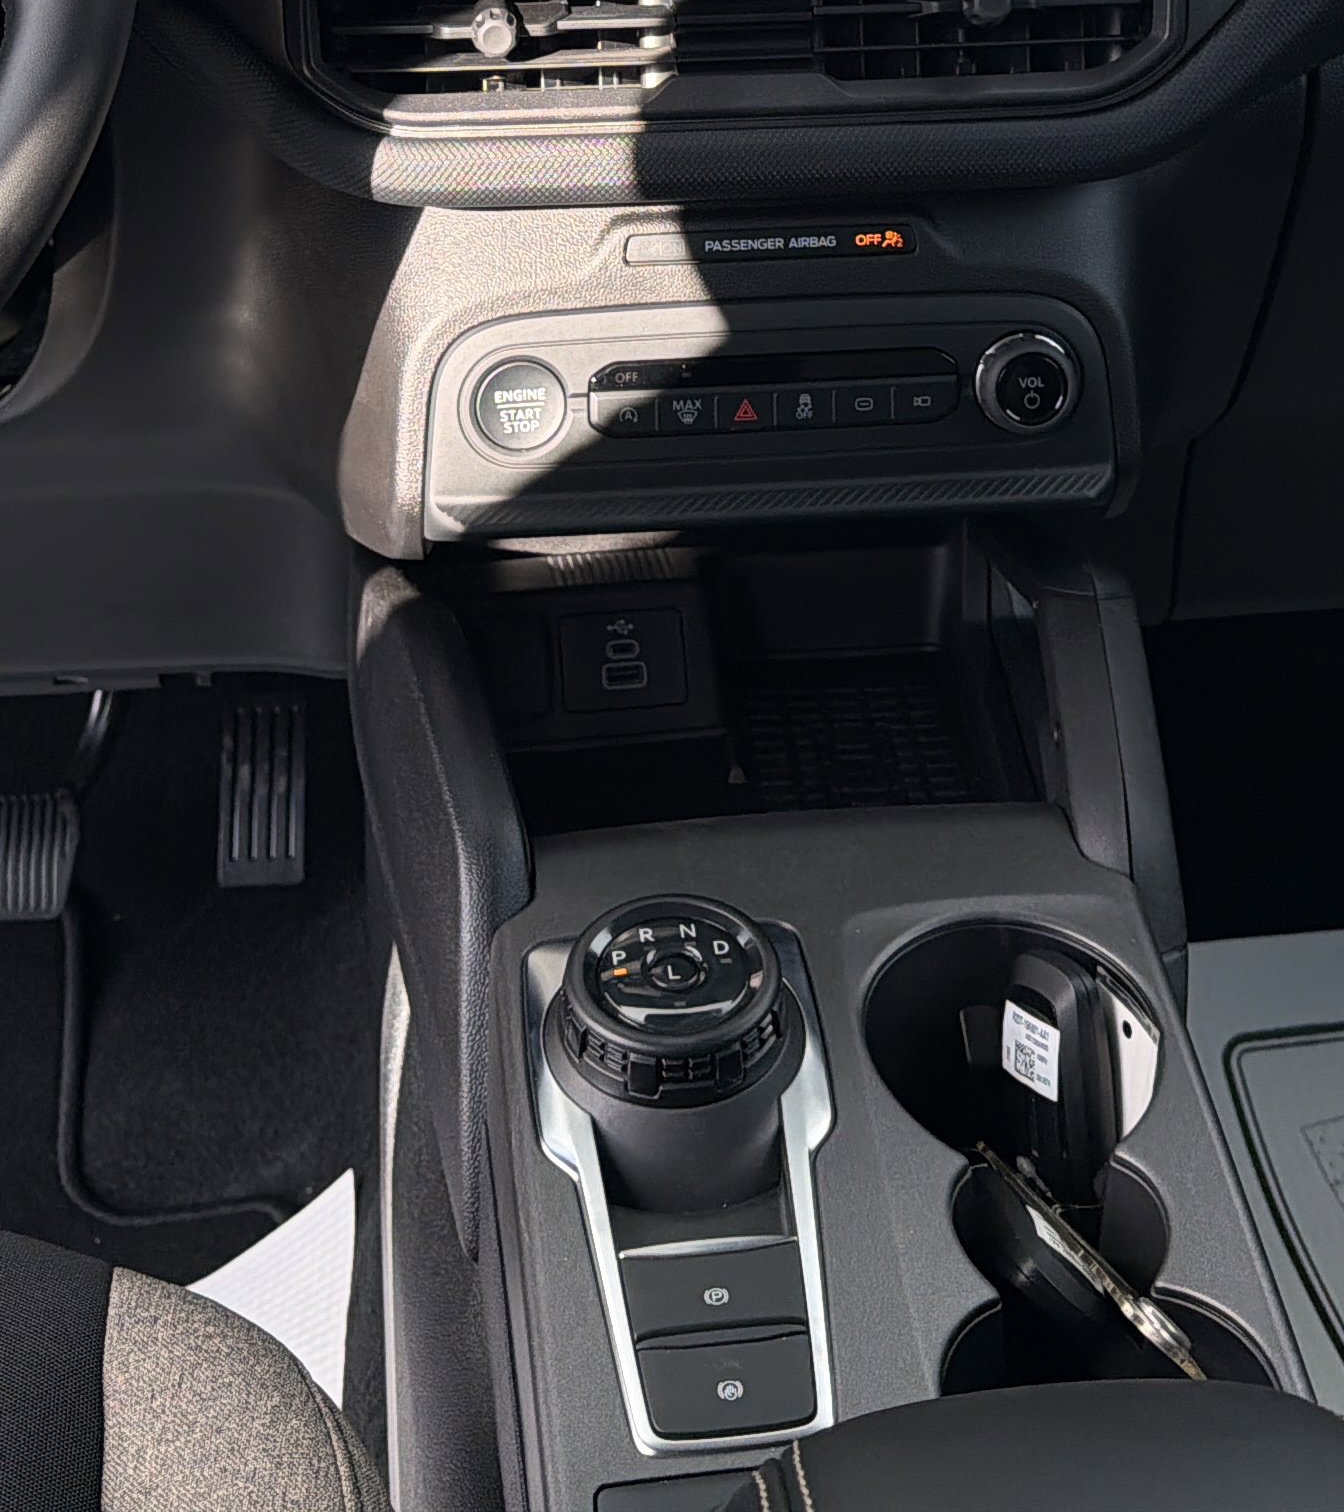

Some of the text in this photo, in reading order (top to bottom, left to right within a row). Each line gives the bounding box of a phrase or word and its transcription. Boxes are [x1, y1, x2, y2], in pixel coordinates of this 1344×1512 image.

[704, 235, 837, 252] PASSENGER AIRBAG
[855, 234, 882, 247] OFF
[614, 371, 639, 384] OFF
[1019, 377, 1045, 388] VOL
[494, 388, 546, 403] ENGINE
[672, 399, 703, 411] MAX
[499, 408, 542, 423] START
[795, 411, 813, 420] OFF
[503, 420, 541, 435] STOP
[612, 923, 730, 966] P R N D
[667, 965, 681, 980] L
